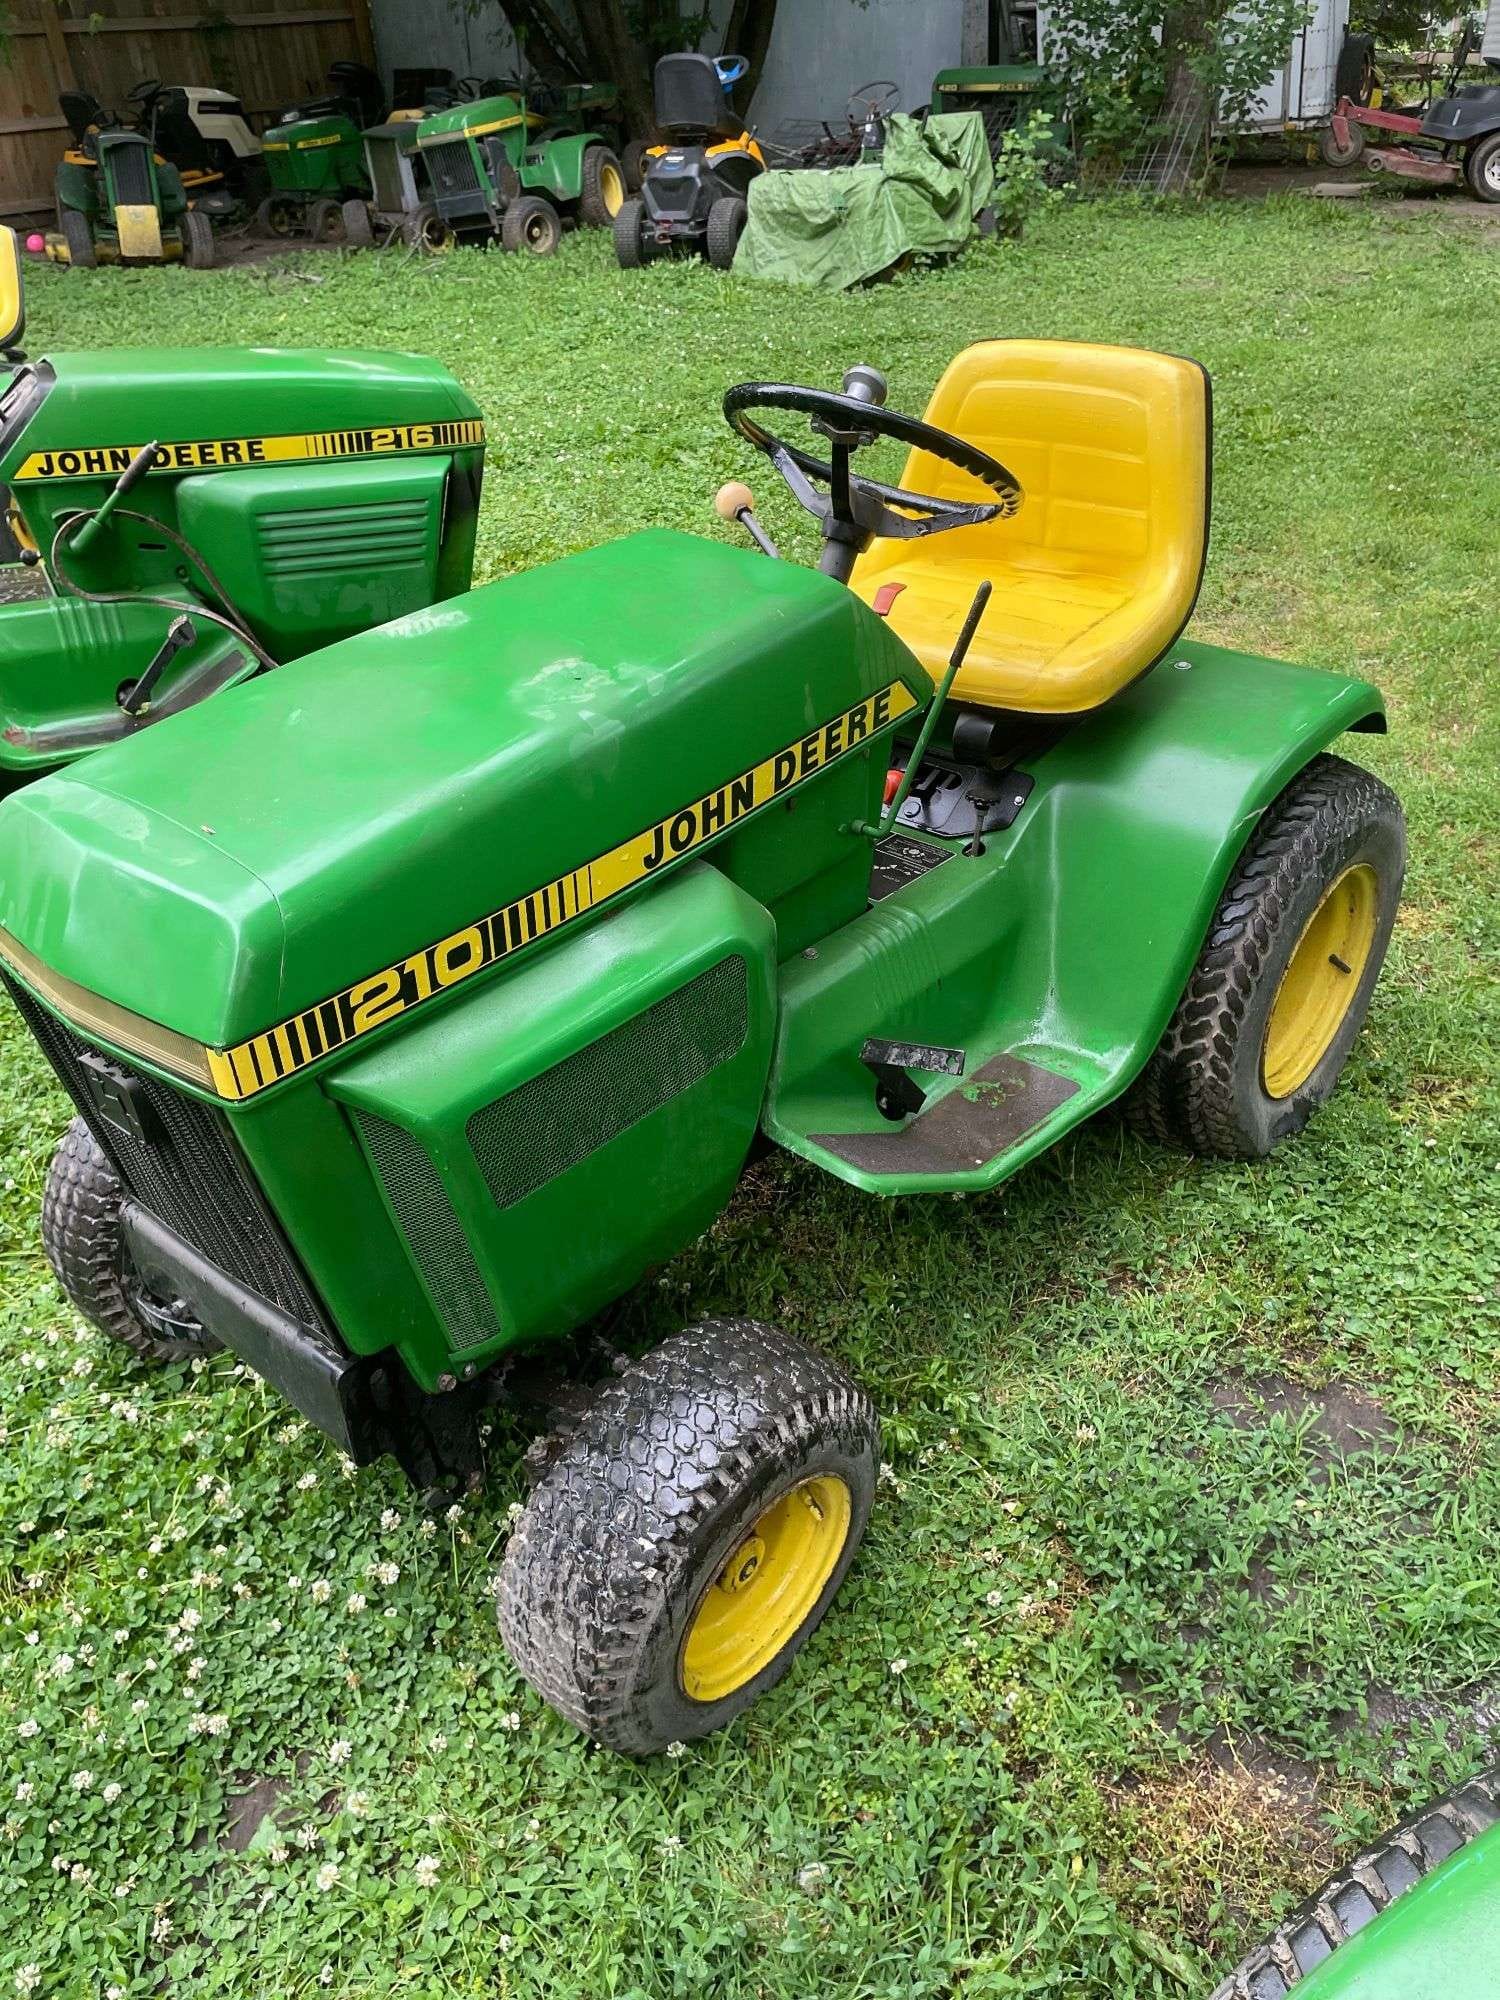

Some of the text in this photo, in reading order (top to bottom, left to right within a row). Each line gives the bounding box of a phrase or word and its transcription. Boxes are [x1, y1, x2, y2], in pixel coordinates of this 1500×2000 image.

[38, 425, 434, 475] JOHN DEERE 216
[349, 926, 482, 1034] 210
[643, 771, 754, 869] JOHN
[773, 690, 891, 794] DEERE
